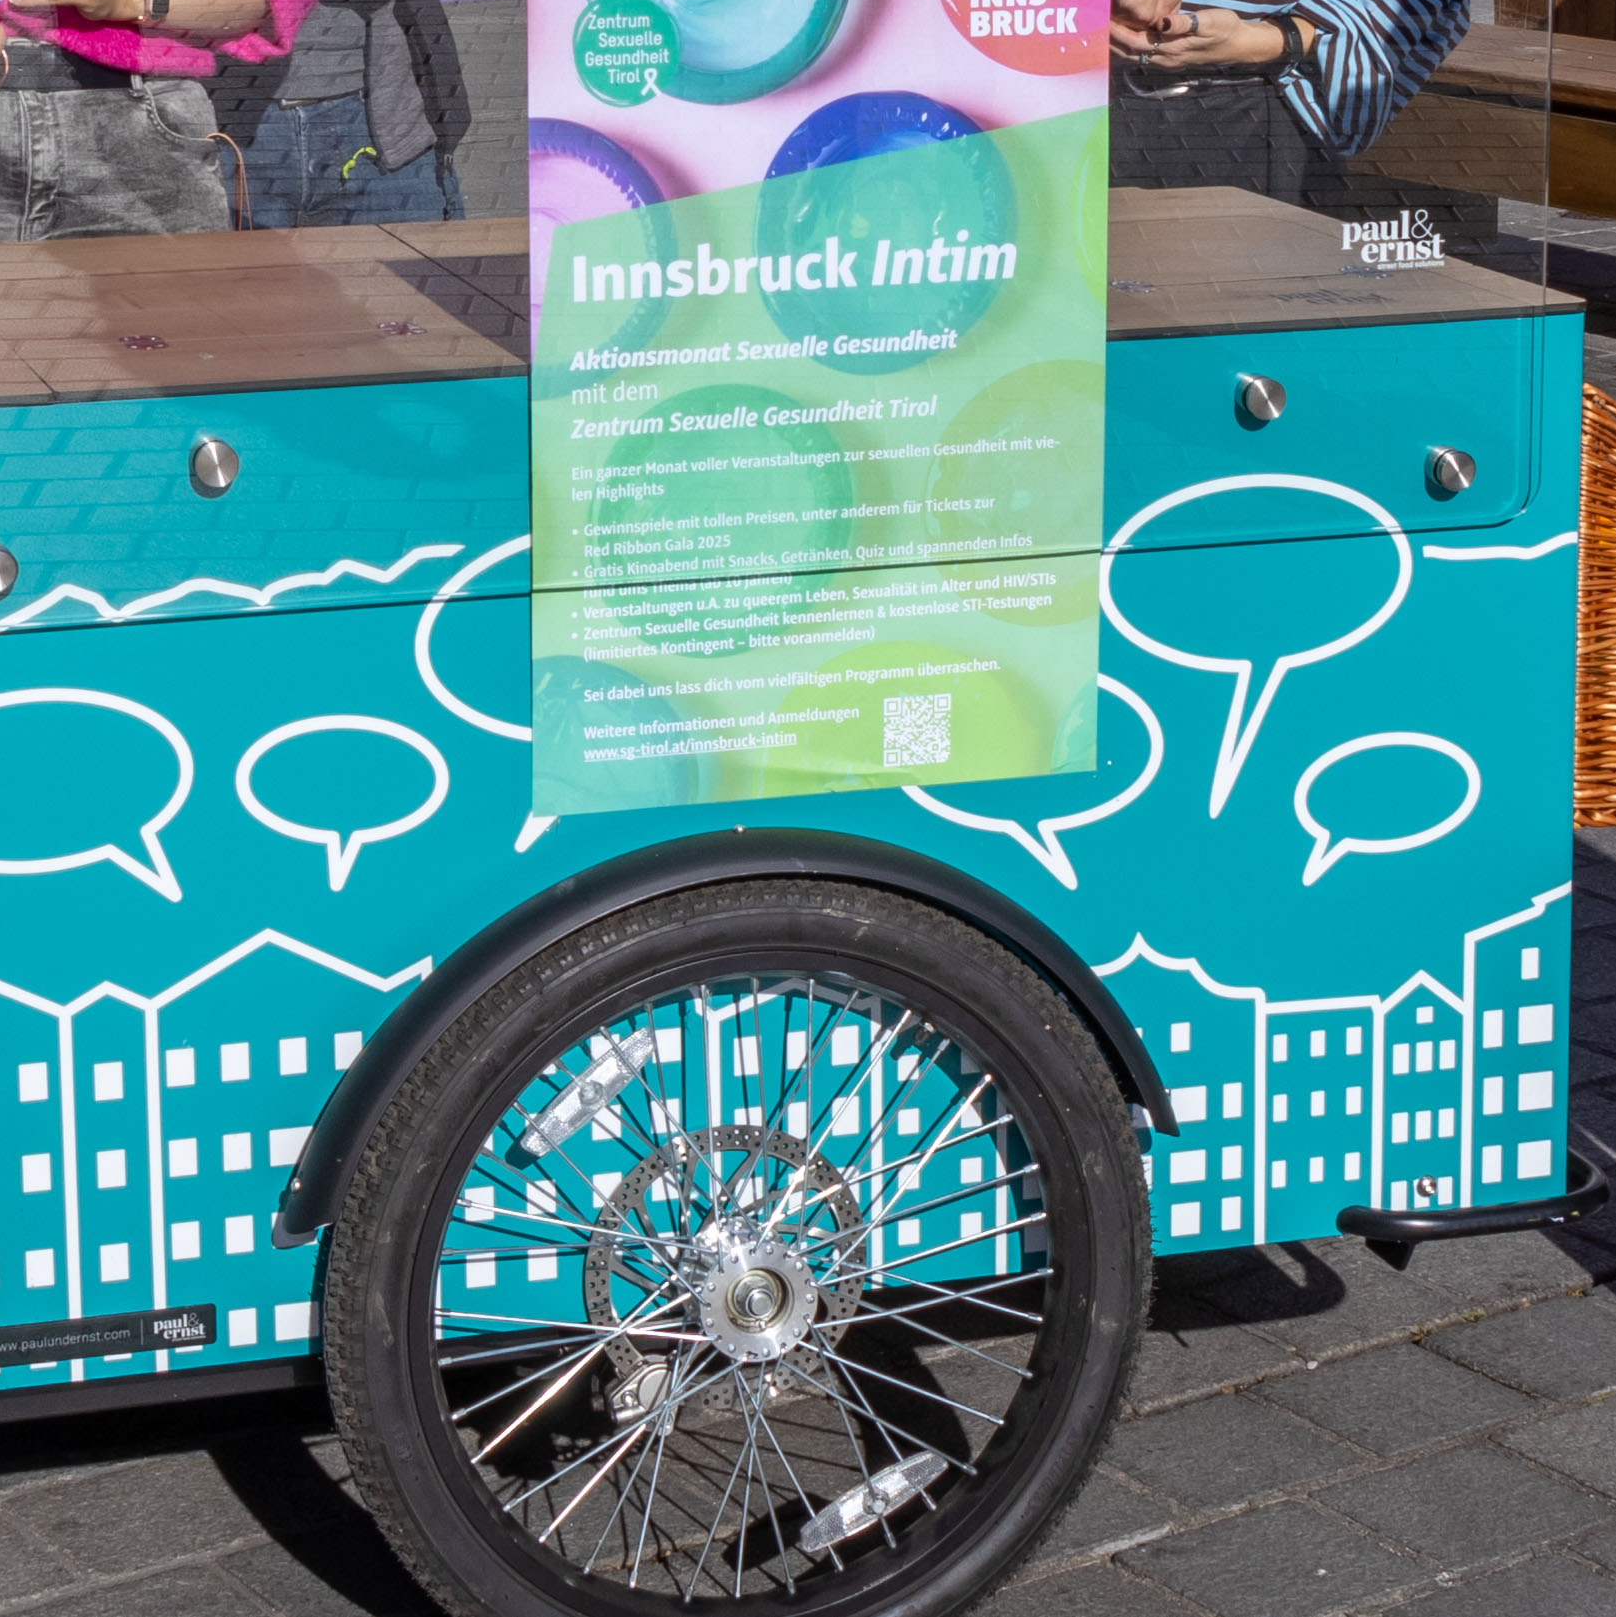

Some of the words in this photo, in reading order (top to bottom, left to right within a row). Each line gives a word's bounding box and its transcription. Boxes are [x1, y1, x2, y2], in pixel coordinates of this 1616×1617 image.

[588, 13, 650, 30] Zentrum
[970, 8, 1077, 37] BRUCK
[598, 31, 662, 47] Sexuelle
[585, 49, 669, 66] Gesundheit
[607, 68, 640, 84] Tirol
[1341, 209, 1433, 250] paul&
[1361, 233, 1445, 263] ernst
[573, 237, 857, 303] Innsbruck
[872, 230, 1017, 286] Intim
[570, 343, 731, 371] Aktionsmonat
[736, 336, 828, 360] Sexuelle
[834, 329, 958, 355] Gesundheit
[572, 382, 606, 405] mit
[613, 381, 658, 402] dem
[571, 417, 662, 439] Zentrum
[669, 407, 758, 432] Sexuelle
[763, 398, 883, 426] Gesundheit
[890, 395, 938, 418] Tirol
[572, 468, 592, 480] Ein
[597, 465, 641, 481] ganzer
[646, 460, 687, 475] Monat
[691, 457, 727, 471] voller
[732, 450, 839, 469] Veranstaltungen
[844, 448, 864, 462] zur
[868, 444, 929, 460] sexuellen
[934, 438, 1007, 455] Gesundheit
[1011, 436, 1032, 450] mit
[1036, 436, 1060, 448] vie-
[572, 488, 592, 501] len
[596, 483, 664, 501] Highlights
[584, 518, 673, 537] Gewinnspiele
[677, 515, 699, 529] mit
[704, 513, 742, 527] tollen
[746, 509, 798, 525] Preisen,
[802, 508, 837, 522] unter
[841, 502, 899, 518] anderem
[903, 501, 922, 514] für
[926, 498, 971, 512] Tickets
[975, 497, 995, 509] zur
[585, 544, 609, 557] Red
[613, 540, 661, 555] Ribbon
[665, 537, 693, 551] Gala
[698, 535, 731, 549] 2025
[585, 564, 623, 578] Gratis
[627, 557, 698, 575] Kinoabend
[702, 553, 724, 568] mit
[729, 550, 777, 568] Snacks,
[781, 547, 853, 564] Getränken,
[856, 546, 884, 561] Quiz
[889, 542, 913, 556] und
[917, 536, 996, 555] spannenden
[1001, 534, 1032, 548] Infos
[584, 598, 692, 620] Veranstaltungen
[724, 596, 739, 609] zu
[743, 594, 802, 610] queerem
[806, 589, 849, 604] Leben,
[852, 583, 918, 600] Sexualität
[921, 581, 937, 594] im
[941, 578, 971, 593] Alter
[975, 576, 999, 590] und
[1004, 572, 1056, 588] HIV/STIs
[584, 625, 641, 641] Zentrum
[645, 618, 699, 635] Sexuelle
[704, 613, 778, 631] Gesundheit
[783, 606, 873, 624] kennenlernen
[877, 606, 887, 618] &
[890, 600, 959, 617] kostenlose
[963, 595, 1052, 613] STI-Testungen
[584, 641, 657, 662] (limitiertes
[661, 637, 734, 656] Kontingent
[749, 633, 780, 648] bitte
[784, 626, 875, 646] voranmelden)
[584, 723, 635, 739] Weitere
[640, 716, 735, 735] Informationen
[739, 712, 764, 727] und
[768, 708, 860, 725] Anmeldungen
[584, 732, 797, 761] www.sg-tirol.at/innsbruck-intim
[163, 1322, 206, 1340] ernst
